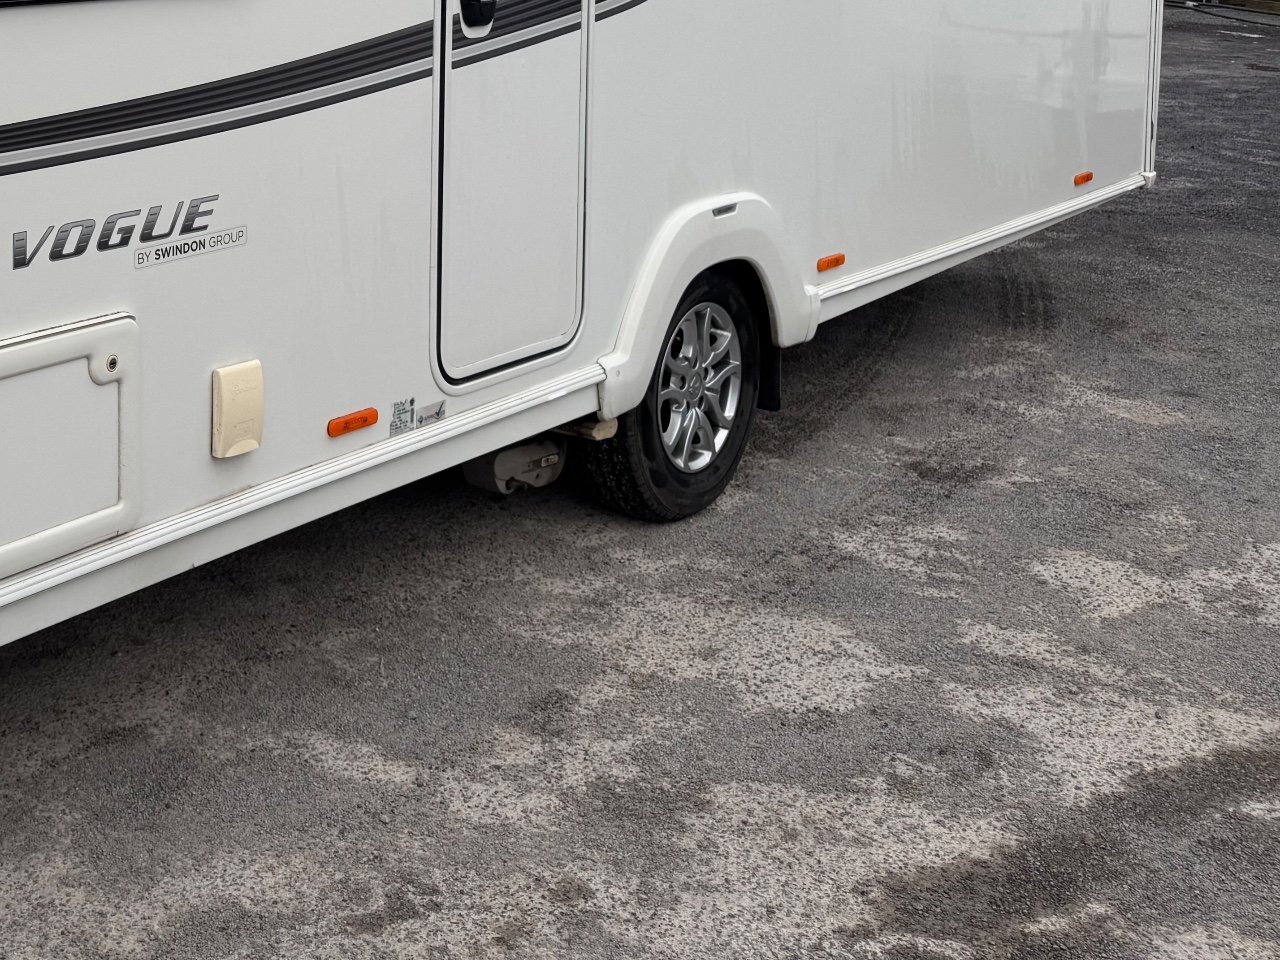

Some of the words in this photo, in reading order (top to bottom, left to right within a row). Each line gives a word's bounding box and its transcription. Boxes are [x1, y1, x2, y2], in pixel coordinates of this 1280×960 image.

[12, 194, 220, 271] VOGUE
[137, 250, 152, 265] BY
[154, 239, 206, 261] SWINDON
[208, 230, 245, 249] GROUP
